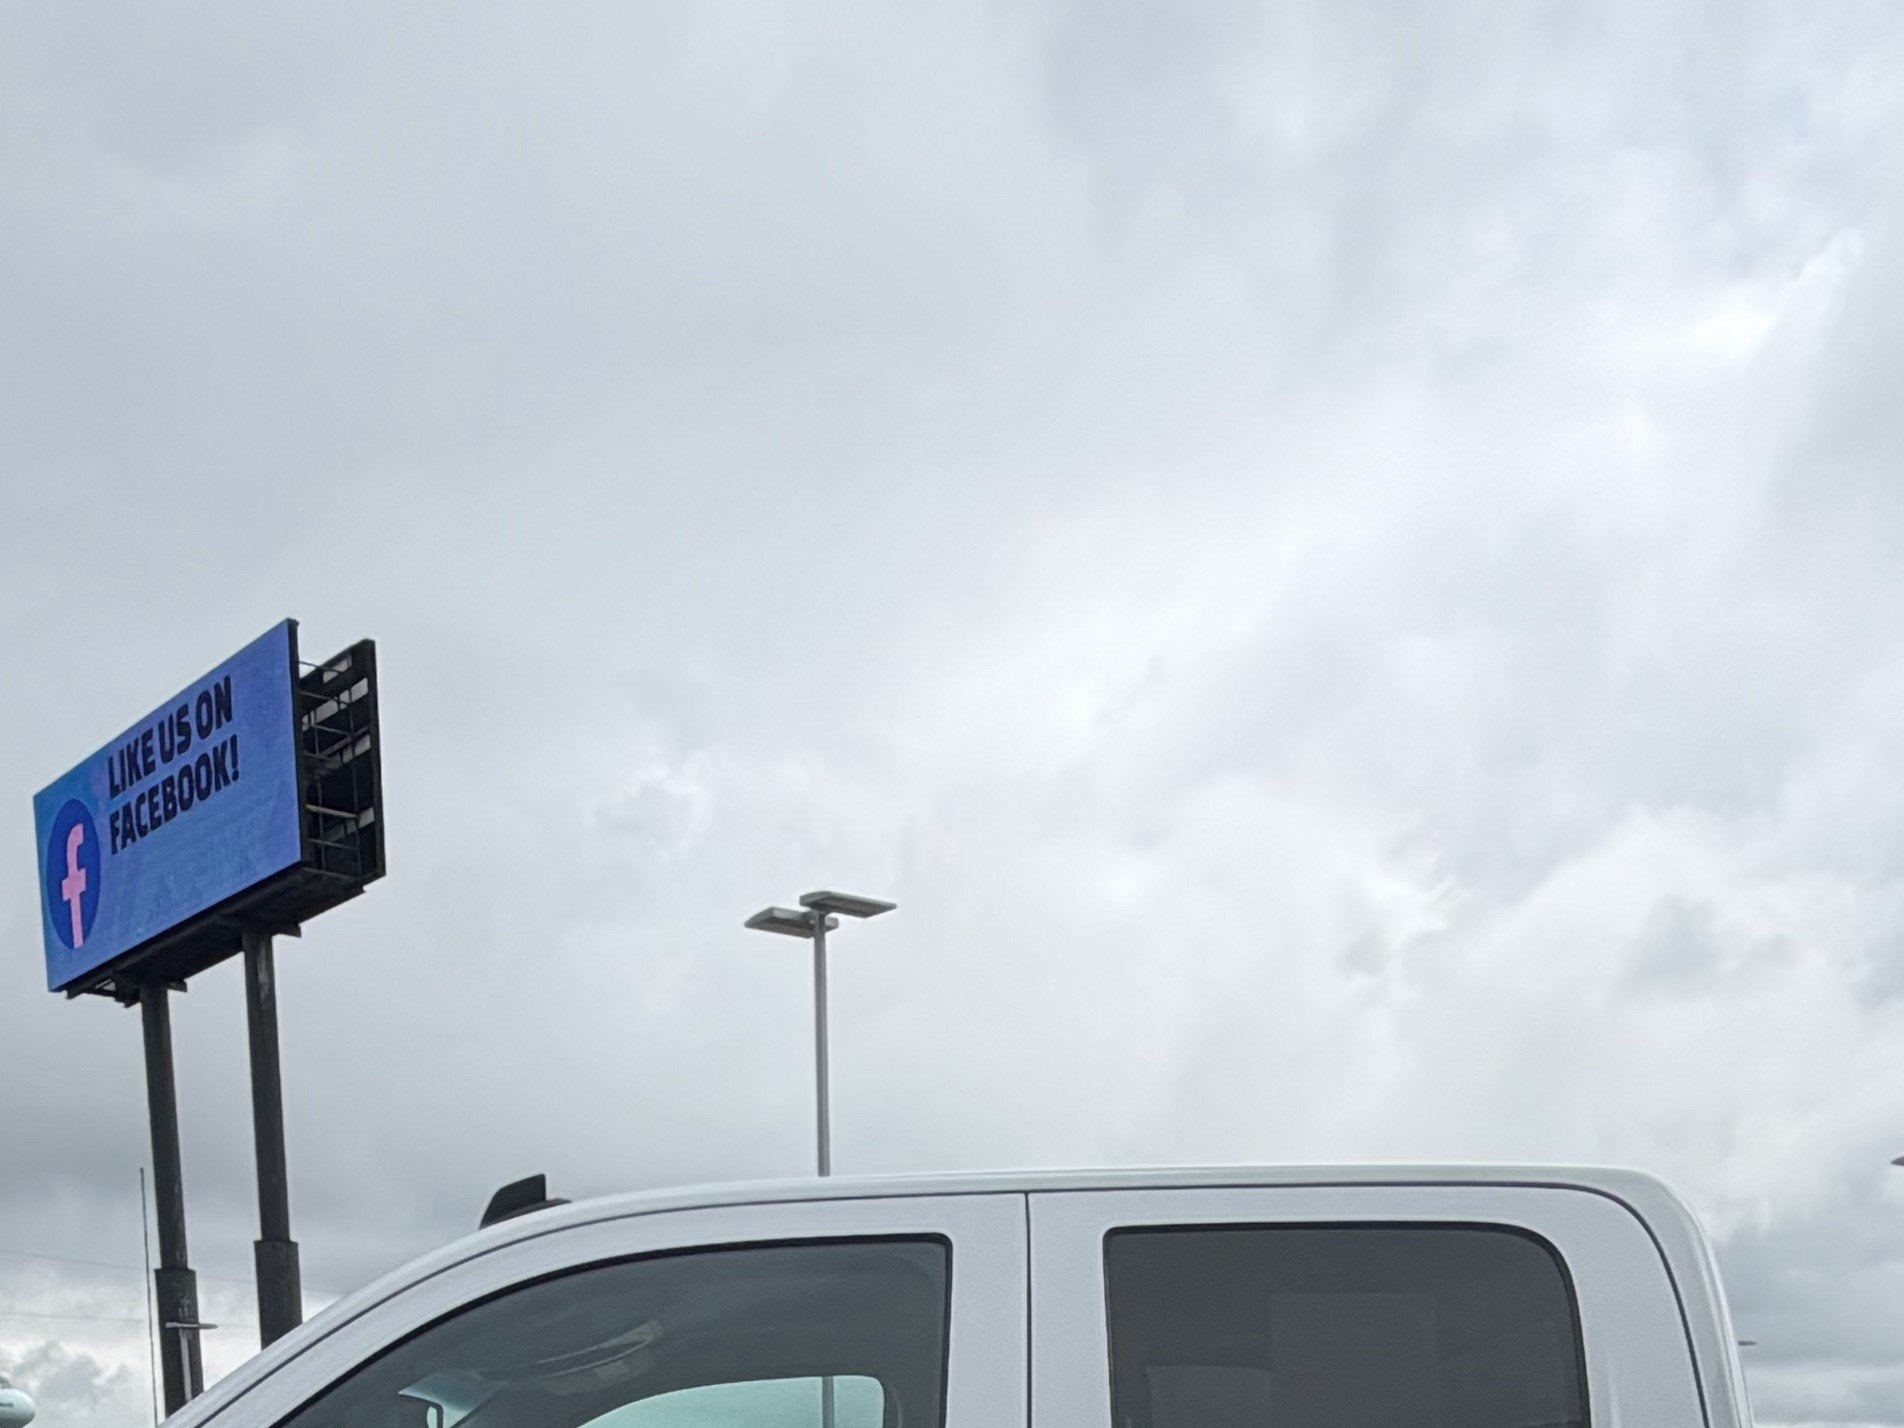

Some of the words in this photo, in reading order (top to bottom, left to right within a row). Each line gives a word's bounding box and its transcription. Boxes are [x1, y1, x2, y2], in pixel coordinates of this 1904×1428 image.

[107, 727, 156, 800] LIKE
[158, 703, 192, 765] US
[196, 674, 233, 740] ON
[109, 733, 240, 855] FACEBOOK!
